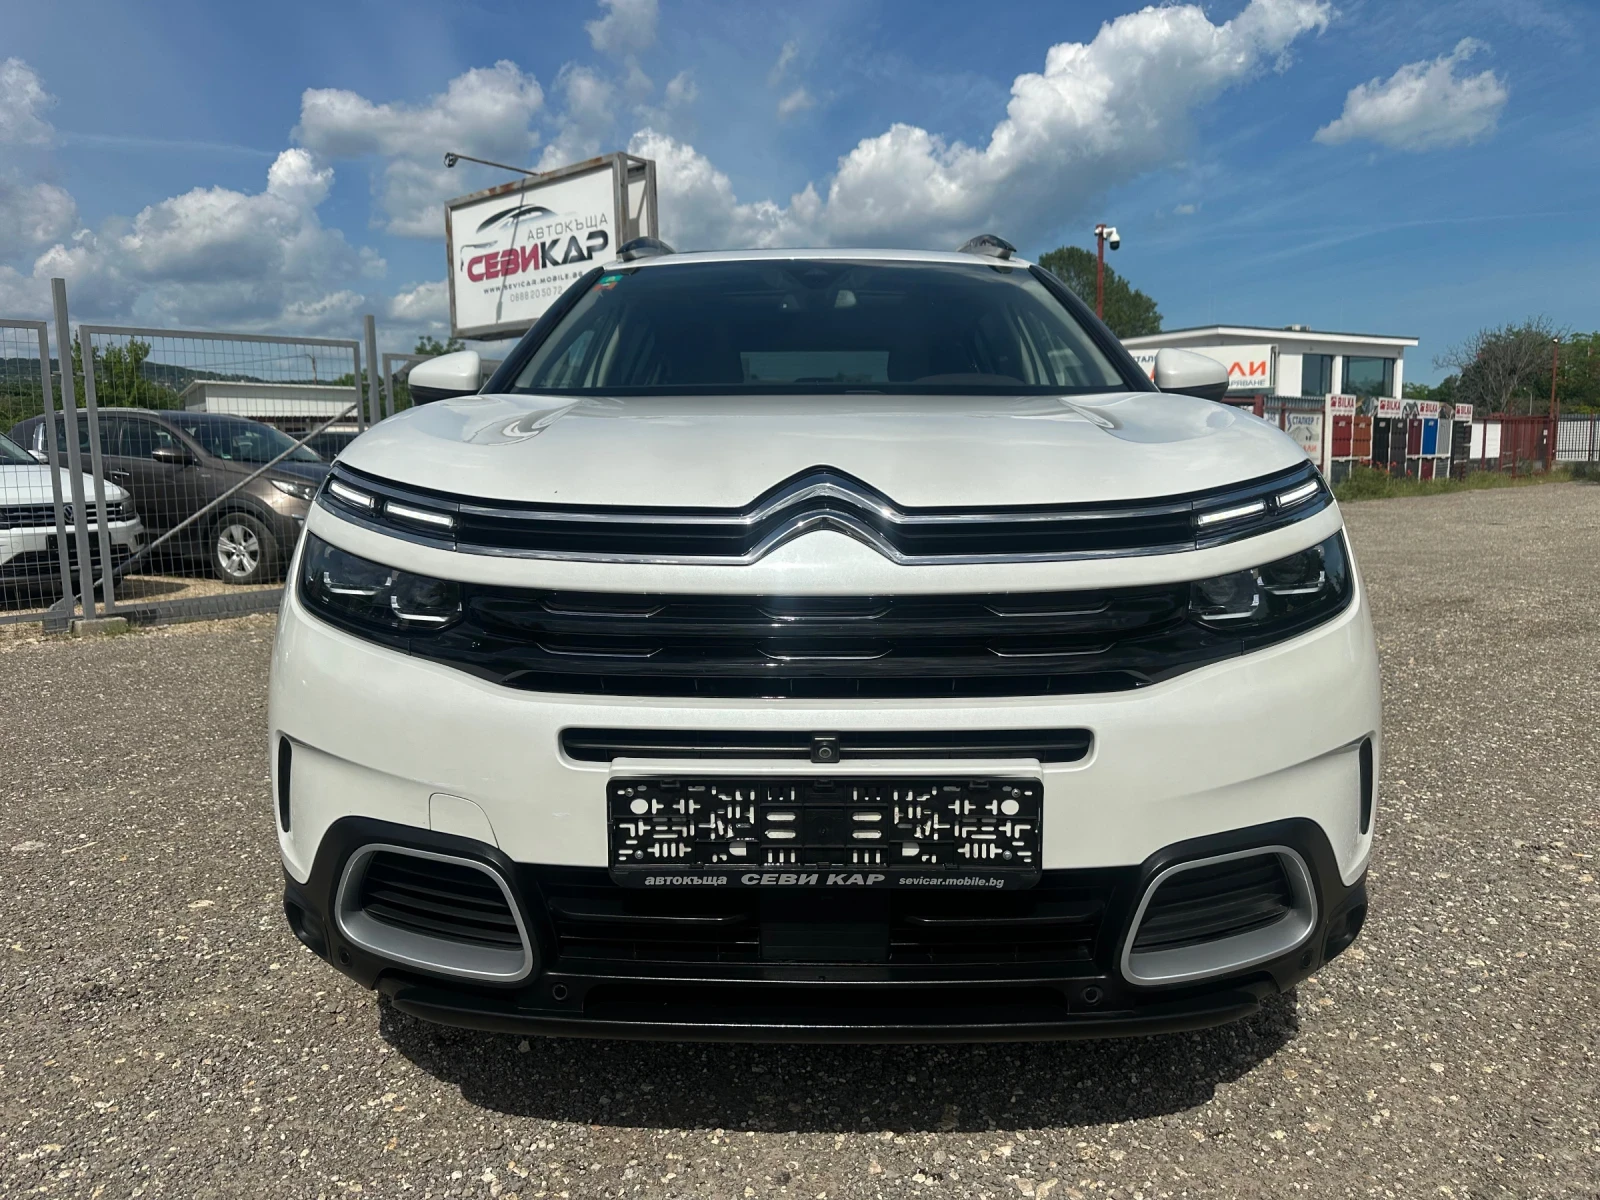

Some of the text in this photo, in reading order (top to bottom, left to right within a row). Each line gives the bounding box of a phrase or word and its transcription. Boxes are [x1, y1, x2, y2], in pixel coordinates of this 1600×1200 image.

[527, 212, 609, 241] АВТОКЪЩА
[1337, 396, 1355, 409] BILKA
[1385, 400, 1401, 410] BILKA
[1425, 403, 1438, 412] BILKA
[644, 873, 886, 886] автокъща СЕВИ КАР
[899, 876, 1005, 888] sevicar.mobile.bg
